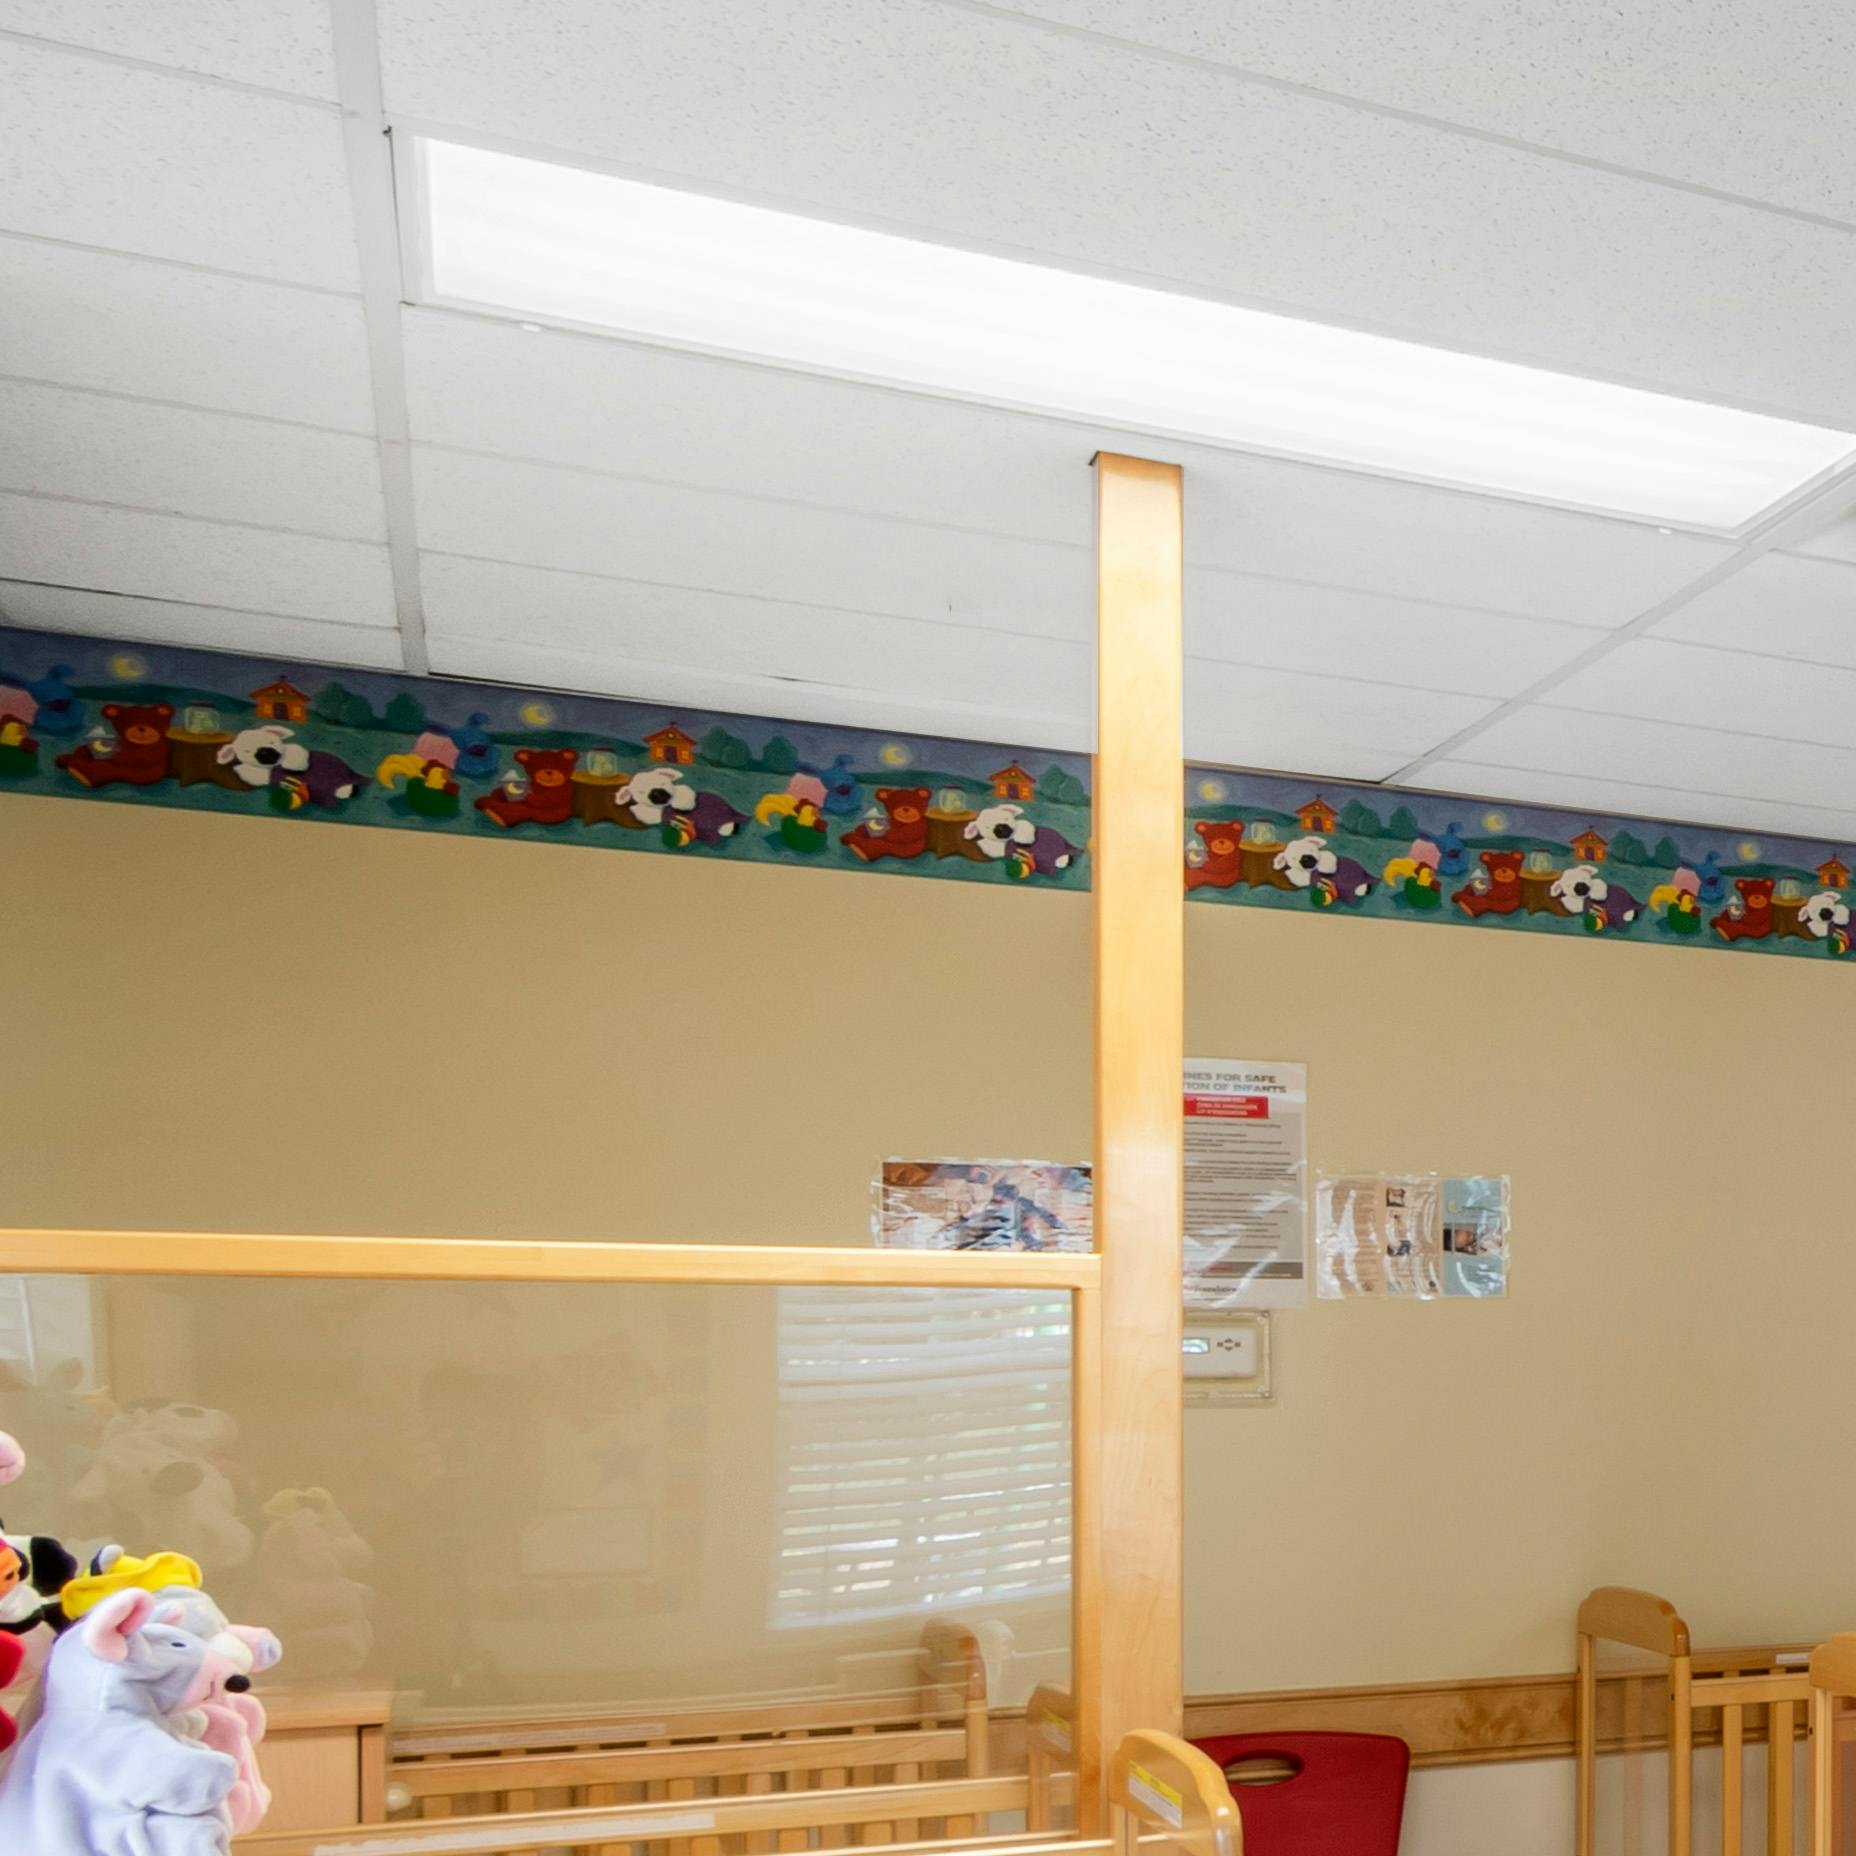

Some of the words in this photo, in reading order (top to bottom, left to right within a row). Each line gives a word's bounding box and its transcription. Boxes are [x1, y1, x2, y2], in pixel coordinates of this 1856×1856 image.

[1216, 1073, 1242, 1082] FOR
[1244, 1074, 1277, 1084] SAFE
[1213, 1082, 1231, 1092] OF
[1233, 1083, 1288, 1094] INFANTS
